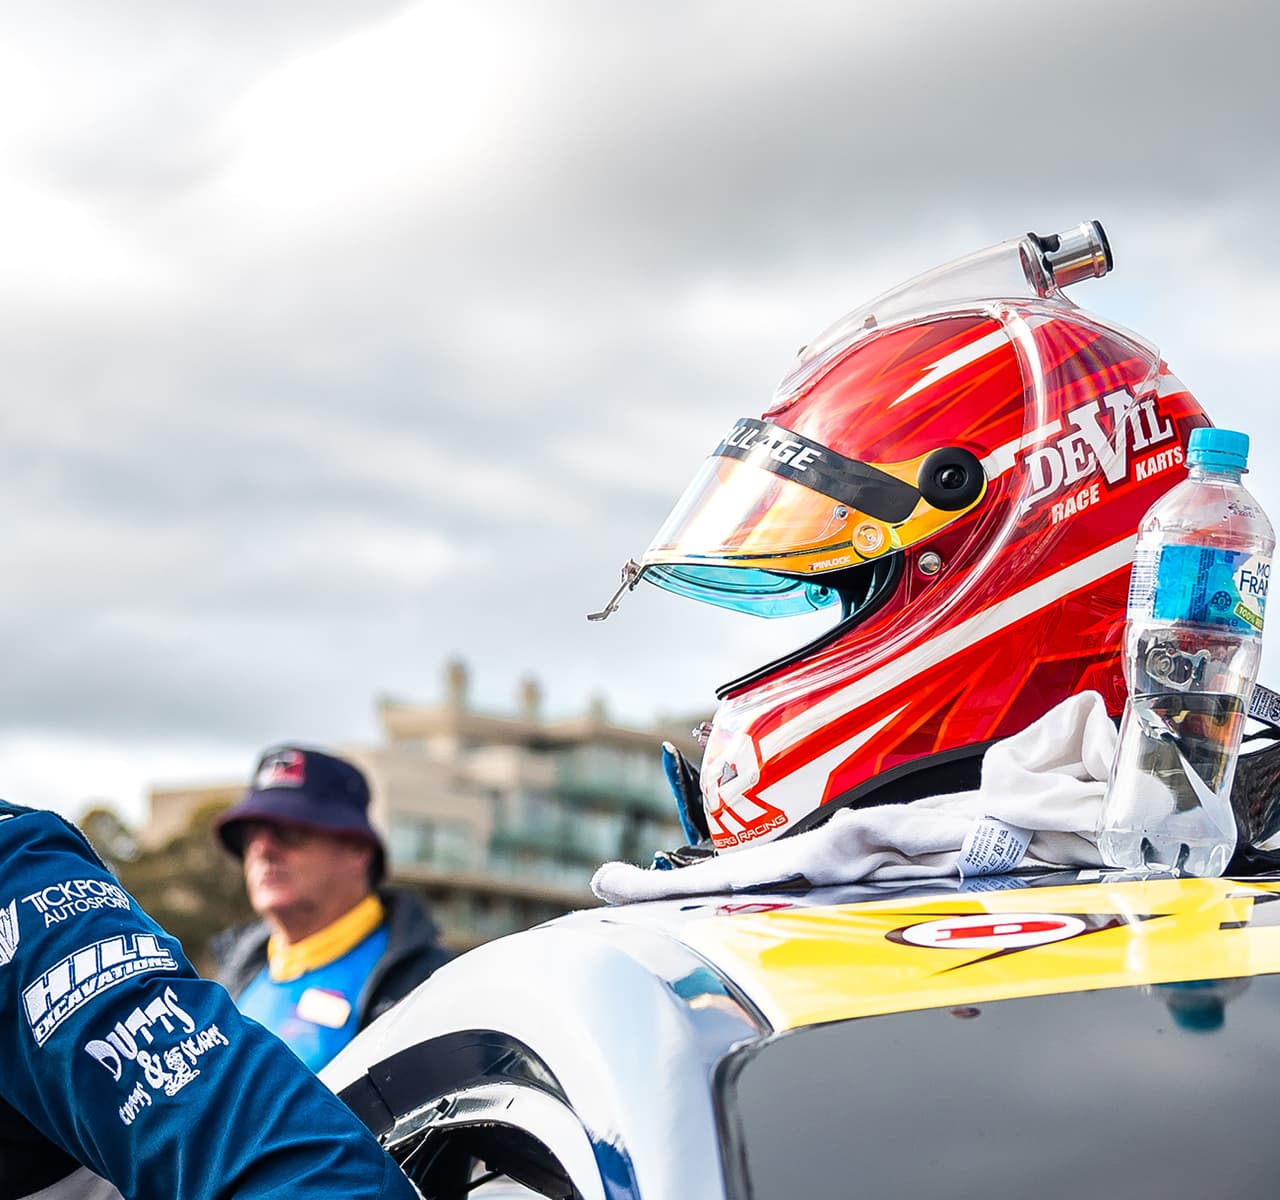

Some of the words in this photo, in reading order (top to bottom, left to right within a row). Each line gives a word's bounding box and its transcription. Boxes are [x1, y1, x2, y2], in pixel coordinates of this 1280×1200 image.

[723, 426, 822, 472] ULAGE
[1020, 388, 1174, 515] DEVIL
[1135, 446, 1183, 482] KARTS
[1051, 483, 1100, 525] RACE
[739, 815, 787, 841] RACING
[22, 880, 129, 913] TICKFORD
[44, 896, 130, 928] AUTOSPORT
[24, 935, 169, 1026] HILL
[36, 957, 176, 1041] EXCAVATIONS
[84, 985, 195, 1082] DUTTS
